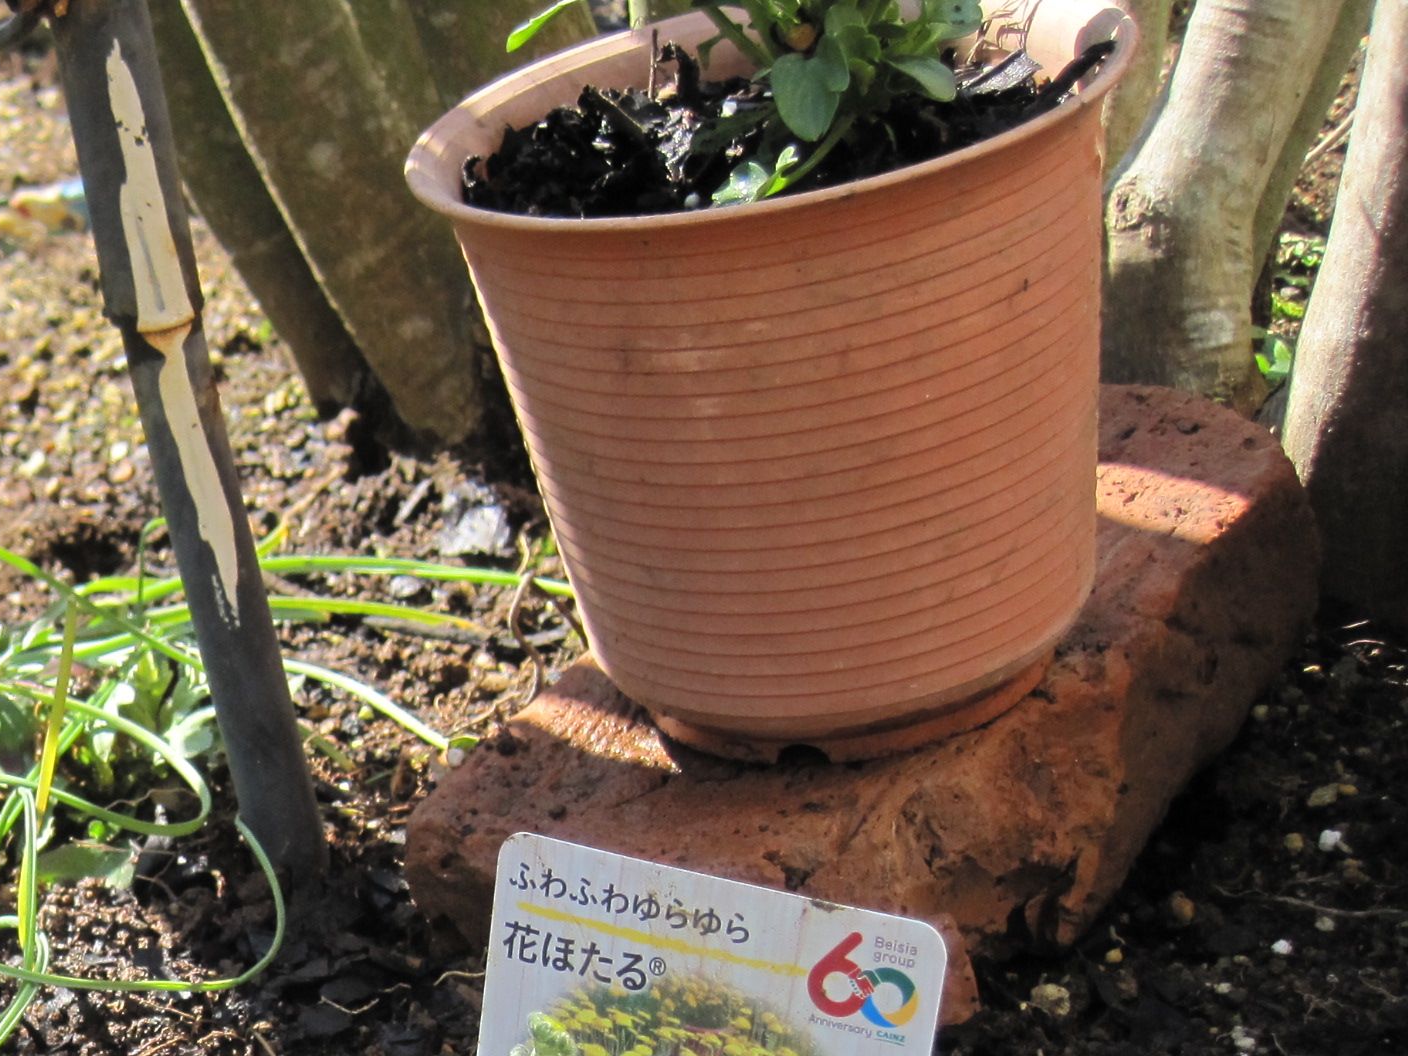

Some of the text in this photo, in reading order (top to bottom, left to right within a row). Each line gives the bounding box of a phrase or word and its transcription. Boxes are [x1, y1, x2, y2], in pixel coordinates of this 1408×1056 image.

[509, 862, 750, 944] ふわふわゆらゆら
[873, 936, 918, 956] Beisia
[873, 950, 916, 969] group
[808, 1013, 907, 1044] Anniversary CAINZ
